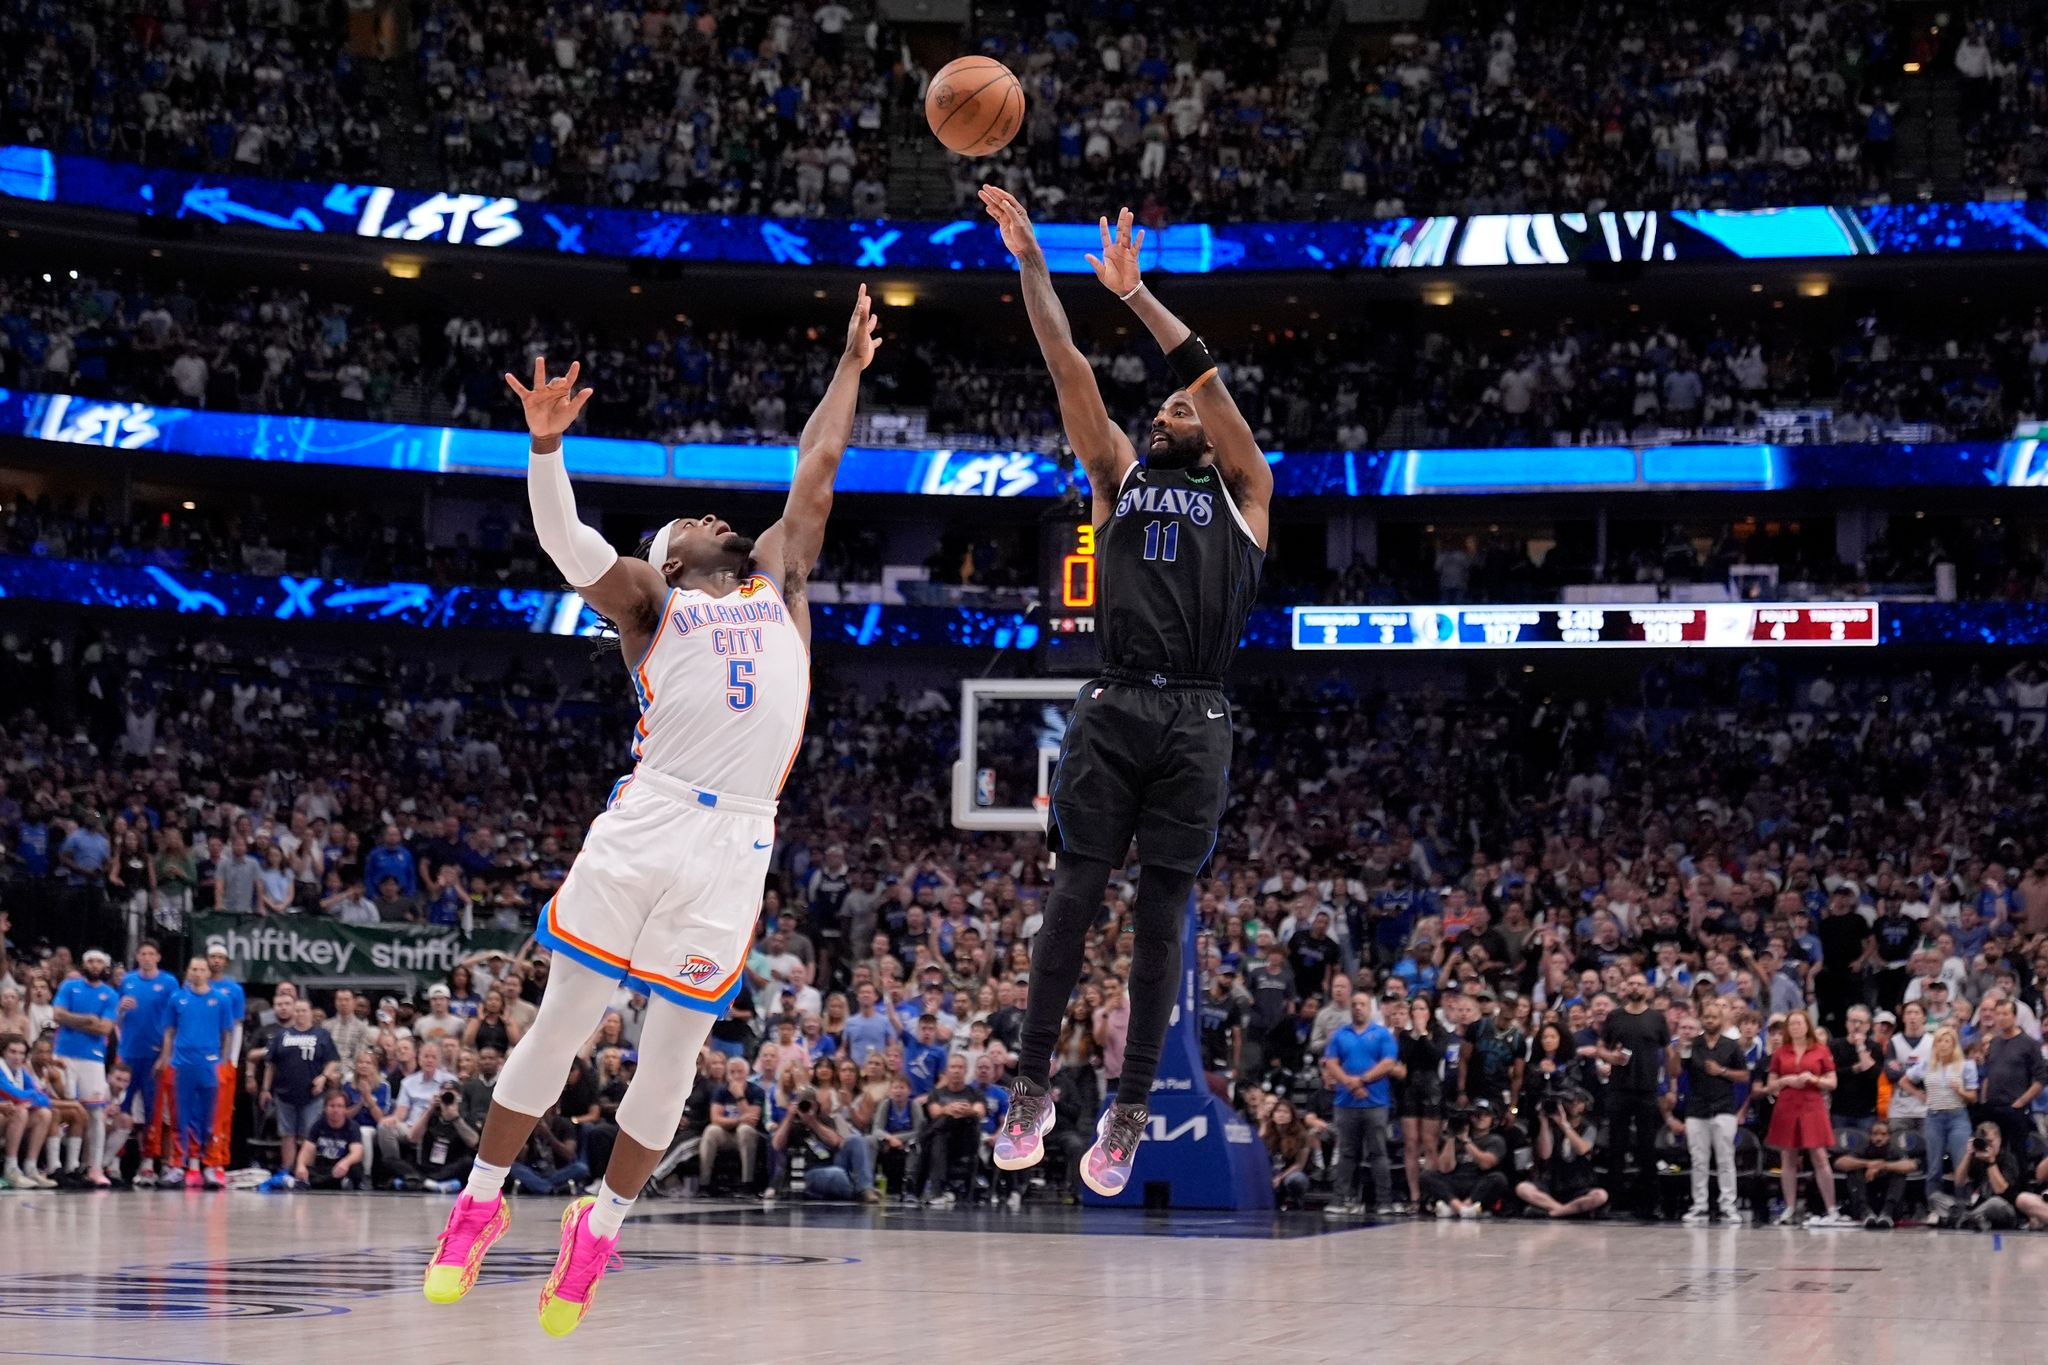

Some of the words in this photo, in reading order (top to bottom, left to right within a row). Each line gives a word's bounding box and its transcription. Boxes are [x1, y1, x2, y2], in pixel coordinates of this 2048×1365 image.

[1115, 487, 1214, 527] MAVS
[1142, 519, 1180, 562] 11
[671, 600, 785, 637] OKLAHOMA
[712, 627, 764, 656] CITY
[726, 657, 757, 713] 5
[371, 937, 473, 972] shiftk
